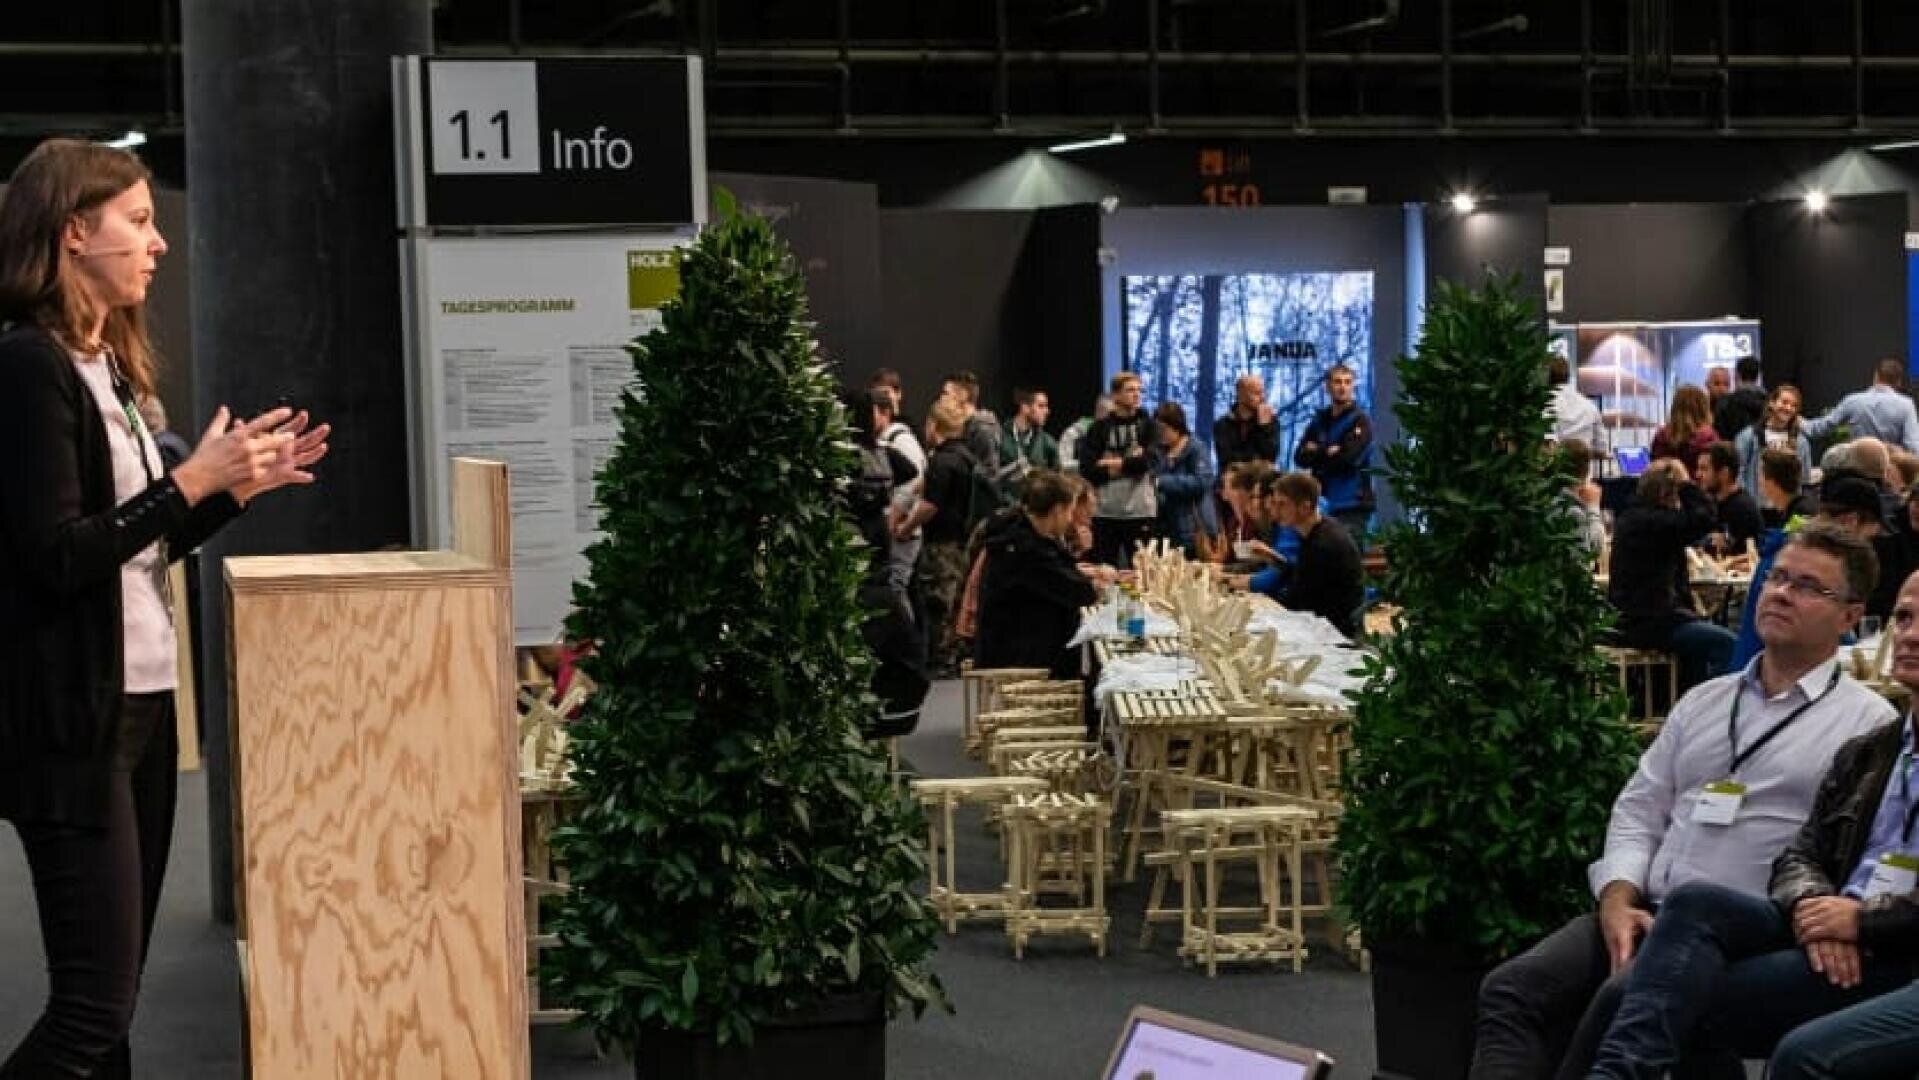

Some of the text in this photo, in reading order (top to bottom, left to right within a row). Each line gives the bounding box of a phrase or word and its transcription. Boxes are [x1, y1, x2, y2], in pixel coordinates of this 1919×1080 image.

[449, 109, 633, 169] 1.1 Info
[441, 299, 576, 314] TAGESPROGRAMM
[1248, 342, 1317, 359] JANUA
